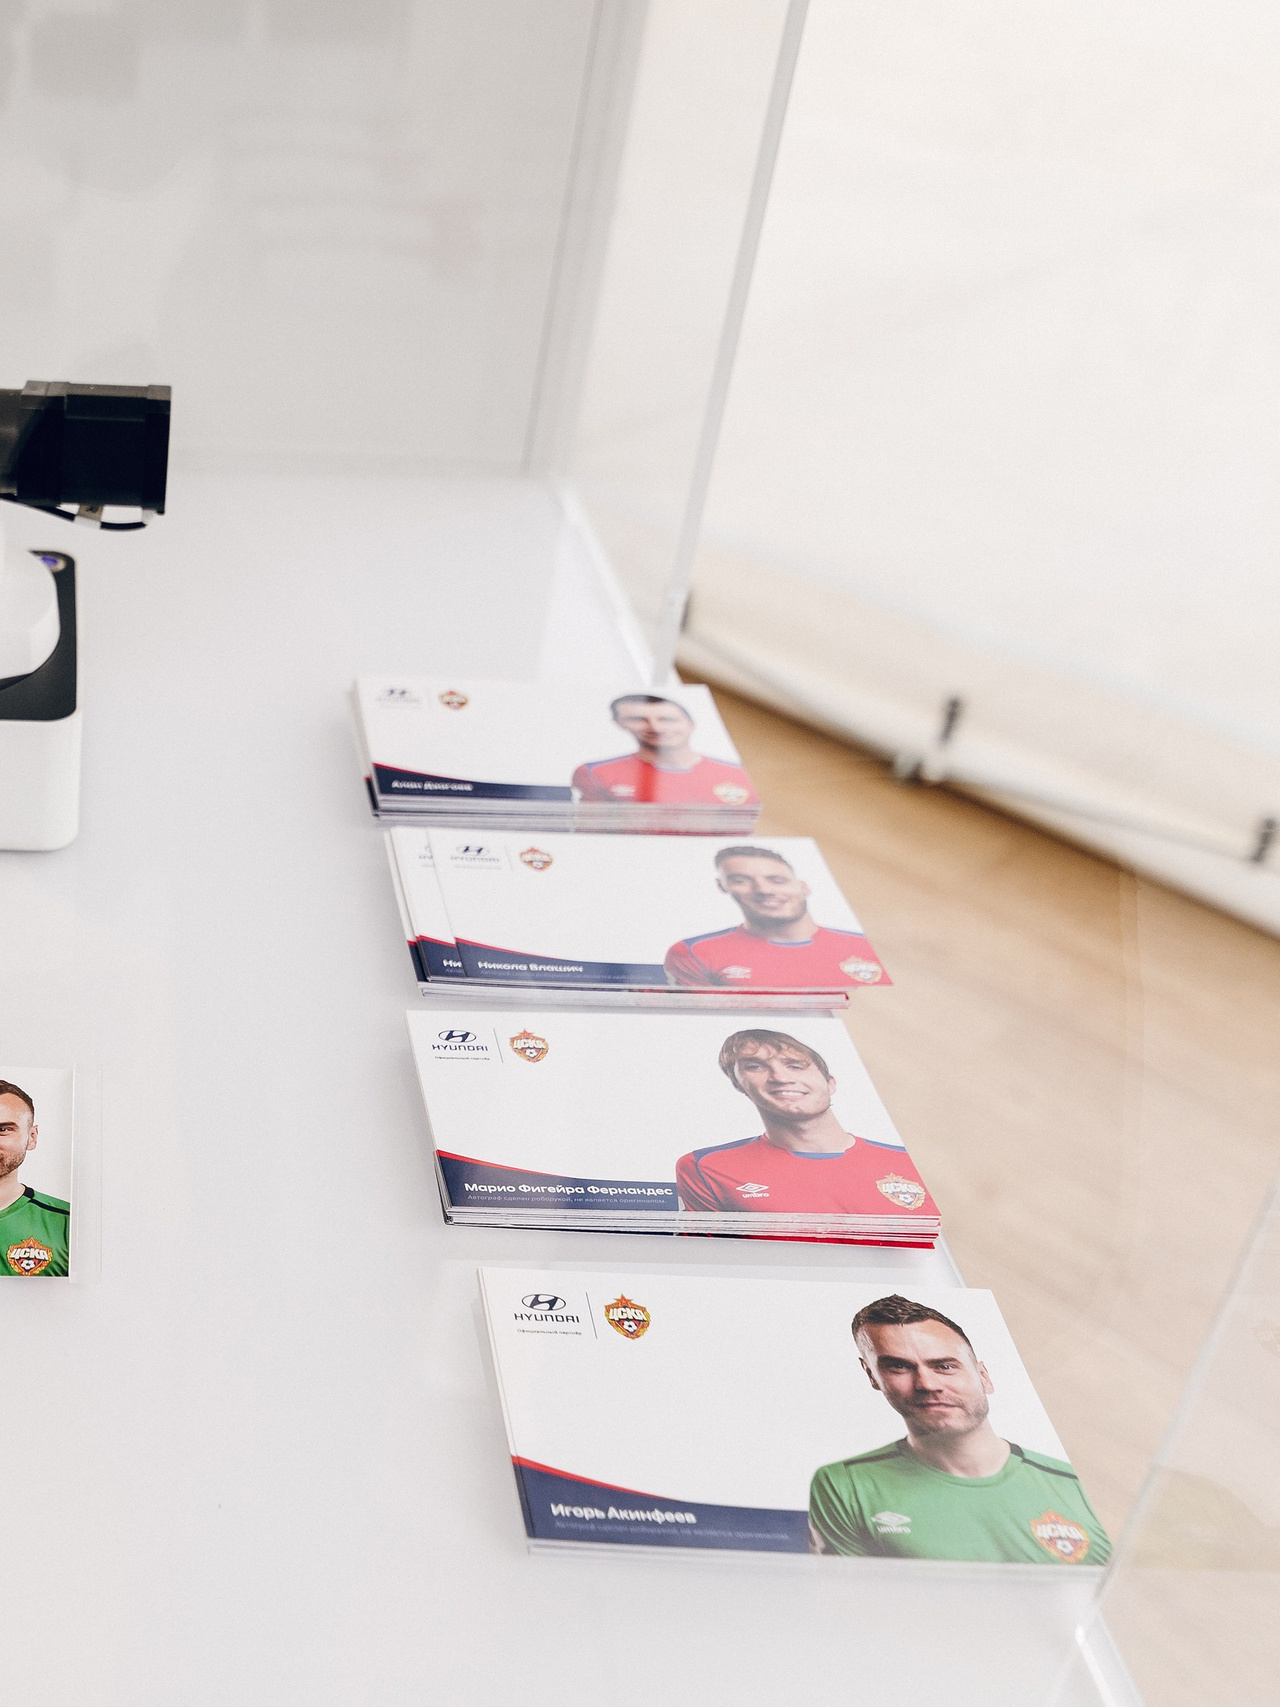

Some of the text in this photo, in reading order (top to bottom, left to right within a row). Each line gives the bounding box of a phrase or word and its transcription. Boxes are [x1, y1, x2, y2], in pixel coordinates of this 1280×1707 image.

[477, 961, 528, 971] Никола
[432, 1044, 489, 1052] HYUNDAI
[464, 1183, 673, 1196] Марио Фигейра Фернандес
[9, 1247, 49, 1260] ЦСКА
[514, 1313, 580, 1323] HYUNDAI
[608, 1308, 648, 1321] ЦСКА
[550, 1503, 697, 1525] Игорь Акинфеев
